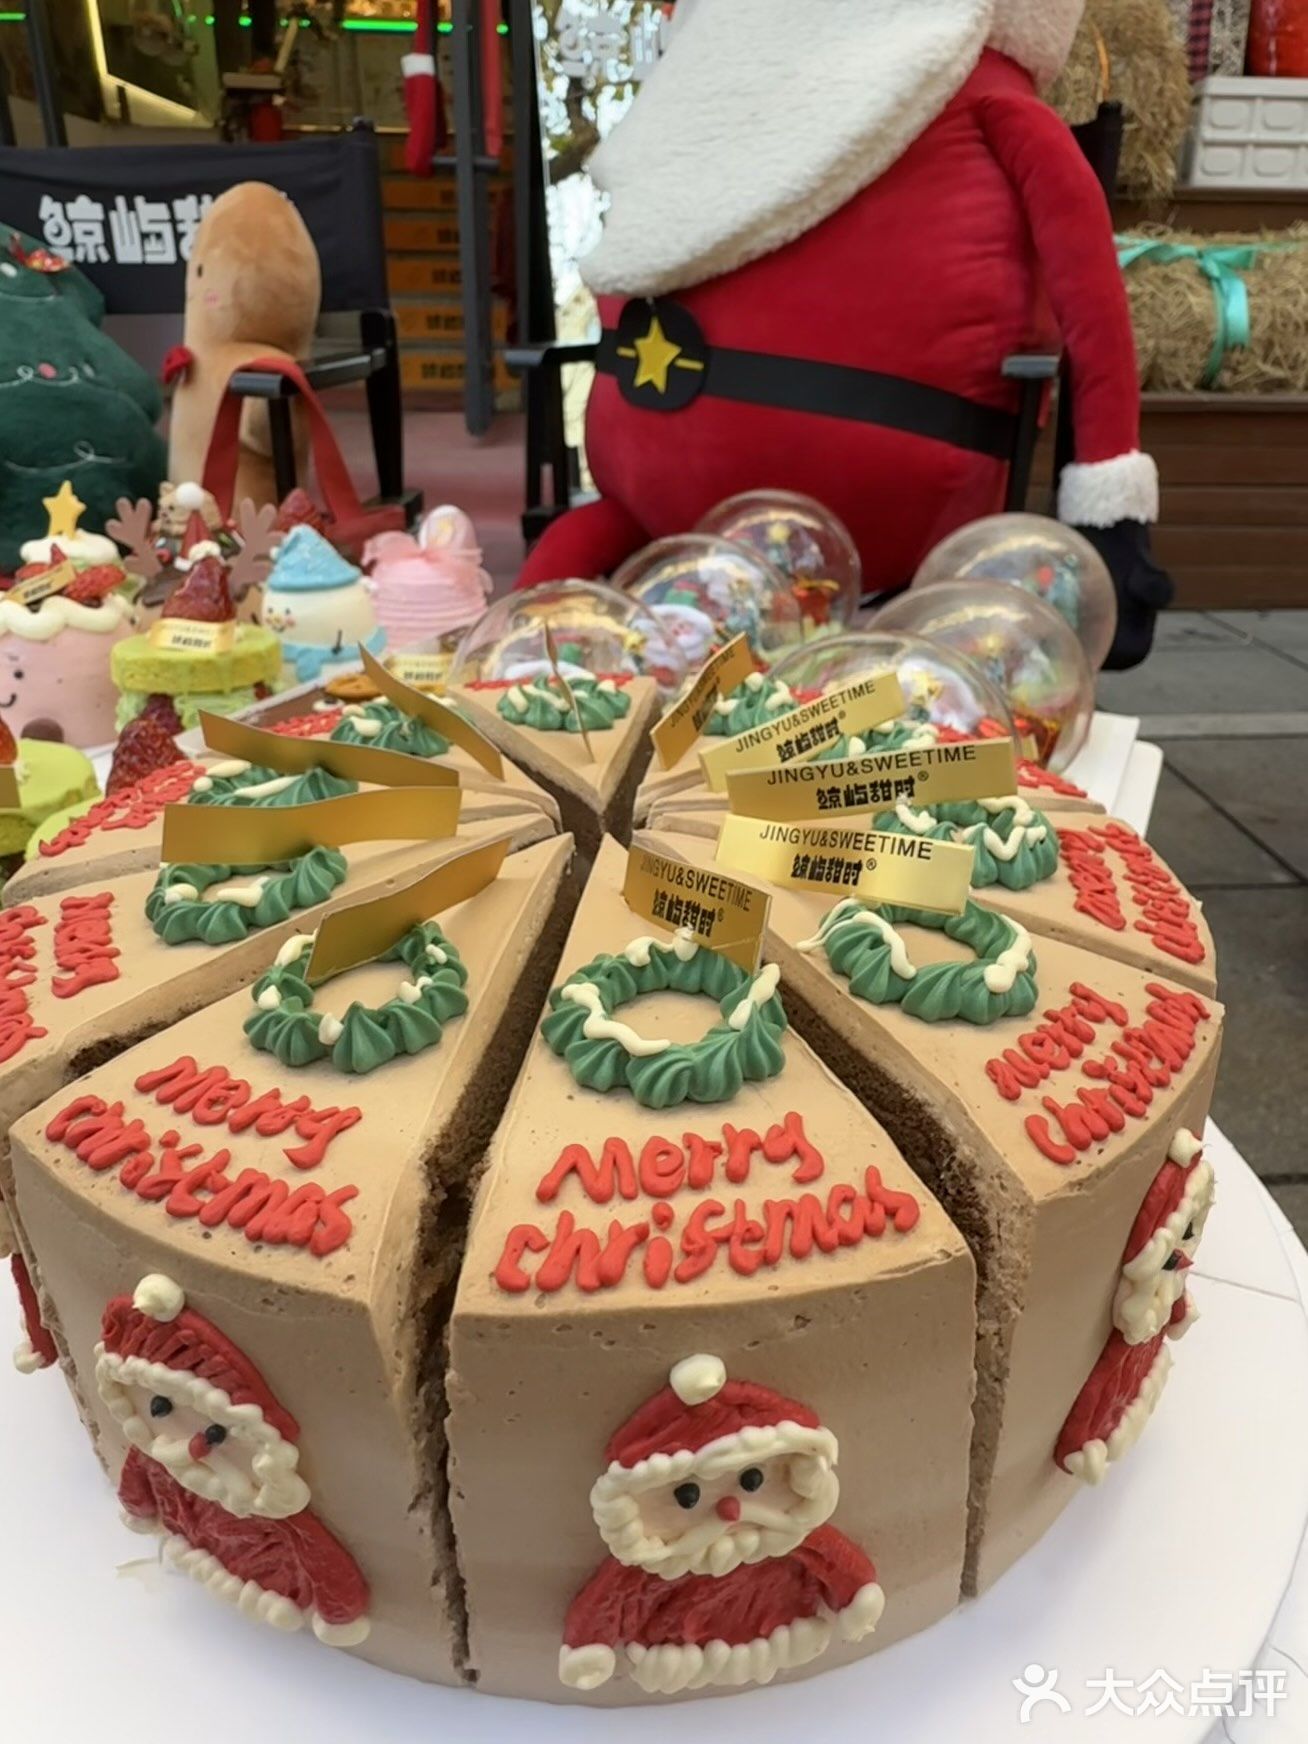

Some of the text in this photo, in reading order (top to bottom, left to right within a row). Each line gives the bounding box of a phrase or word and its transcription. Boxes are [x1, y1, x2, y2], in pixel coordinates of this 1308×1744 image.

[736, 680, 876, 753] JINGYU&SWEETIME
[767, 745, 976, 786] JINGYU&SWEETIME
[759, 824, 934, 860] JINGYU&SWEETIME
[640, 854, 753, 912] JINGYU&SWEETIME
